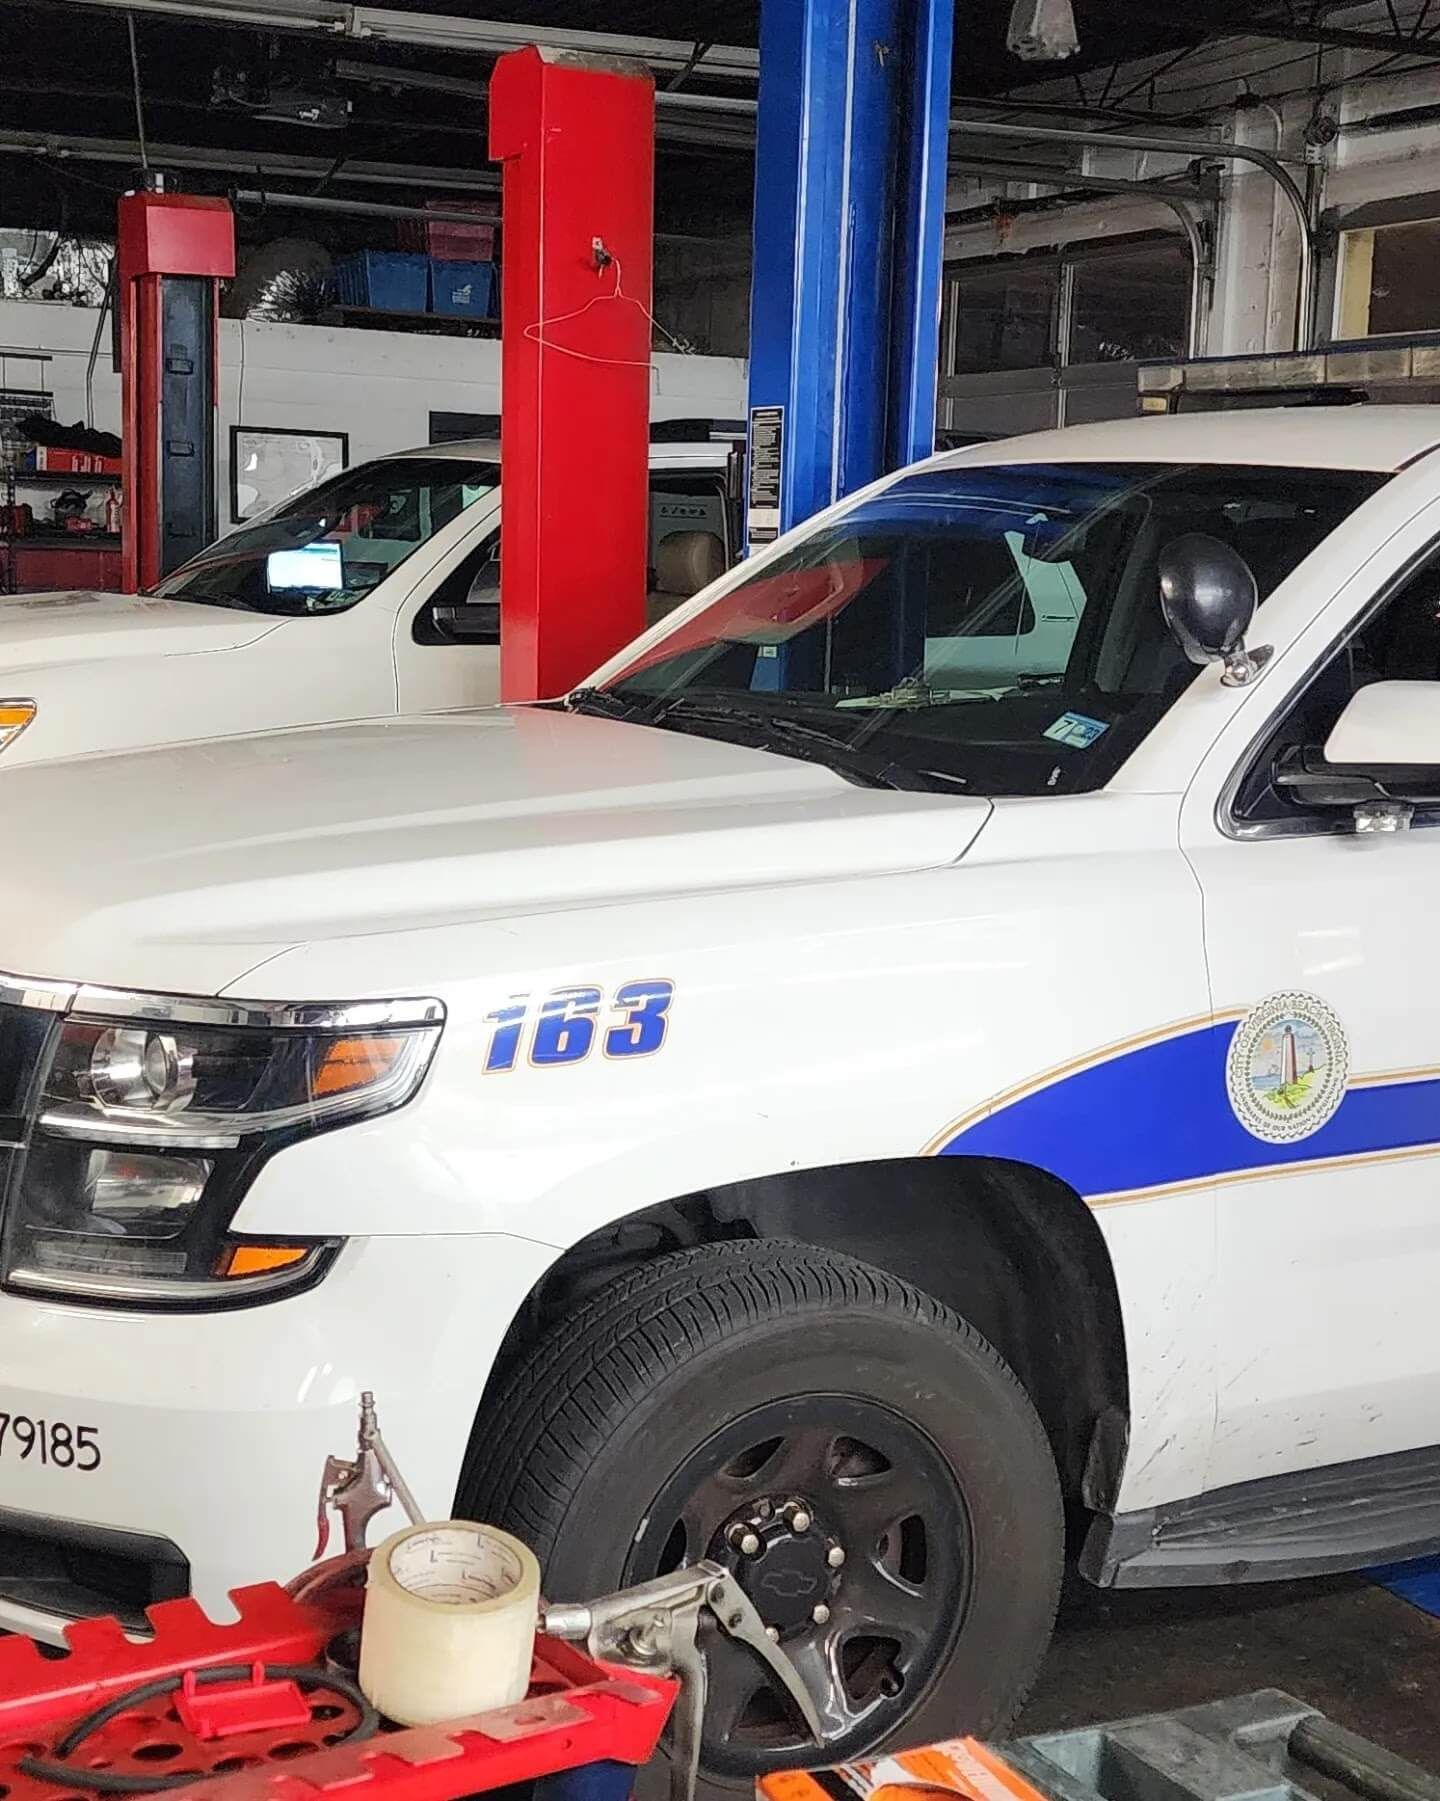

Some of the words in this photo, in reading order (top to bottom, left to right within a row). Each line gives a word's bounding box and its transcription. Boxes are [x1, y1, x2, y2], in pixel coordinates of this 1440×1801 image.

[1054, 719, 1073, 734] 7
[481, 977, 676, 1075] 163
[1235, 1052, 1245, 1079] CITY
[1292, 1000, 1327, 1024] BEACH
[0, 1412, 101, 1472] 79185
